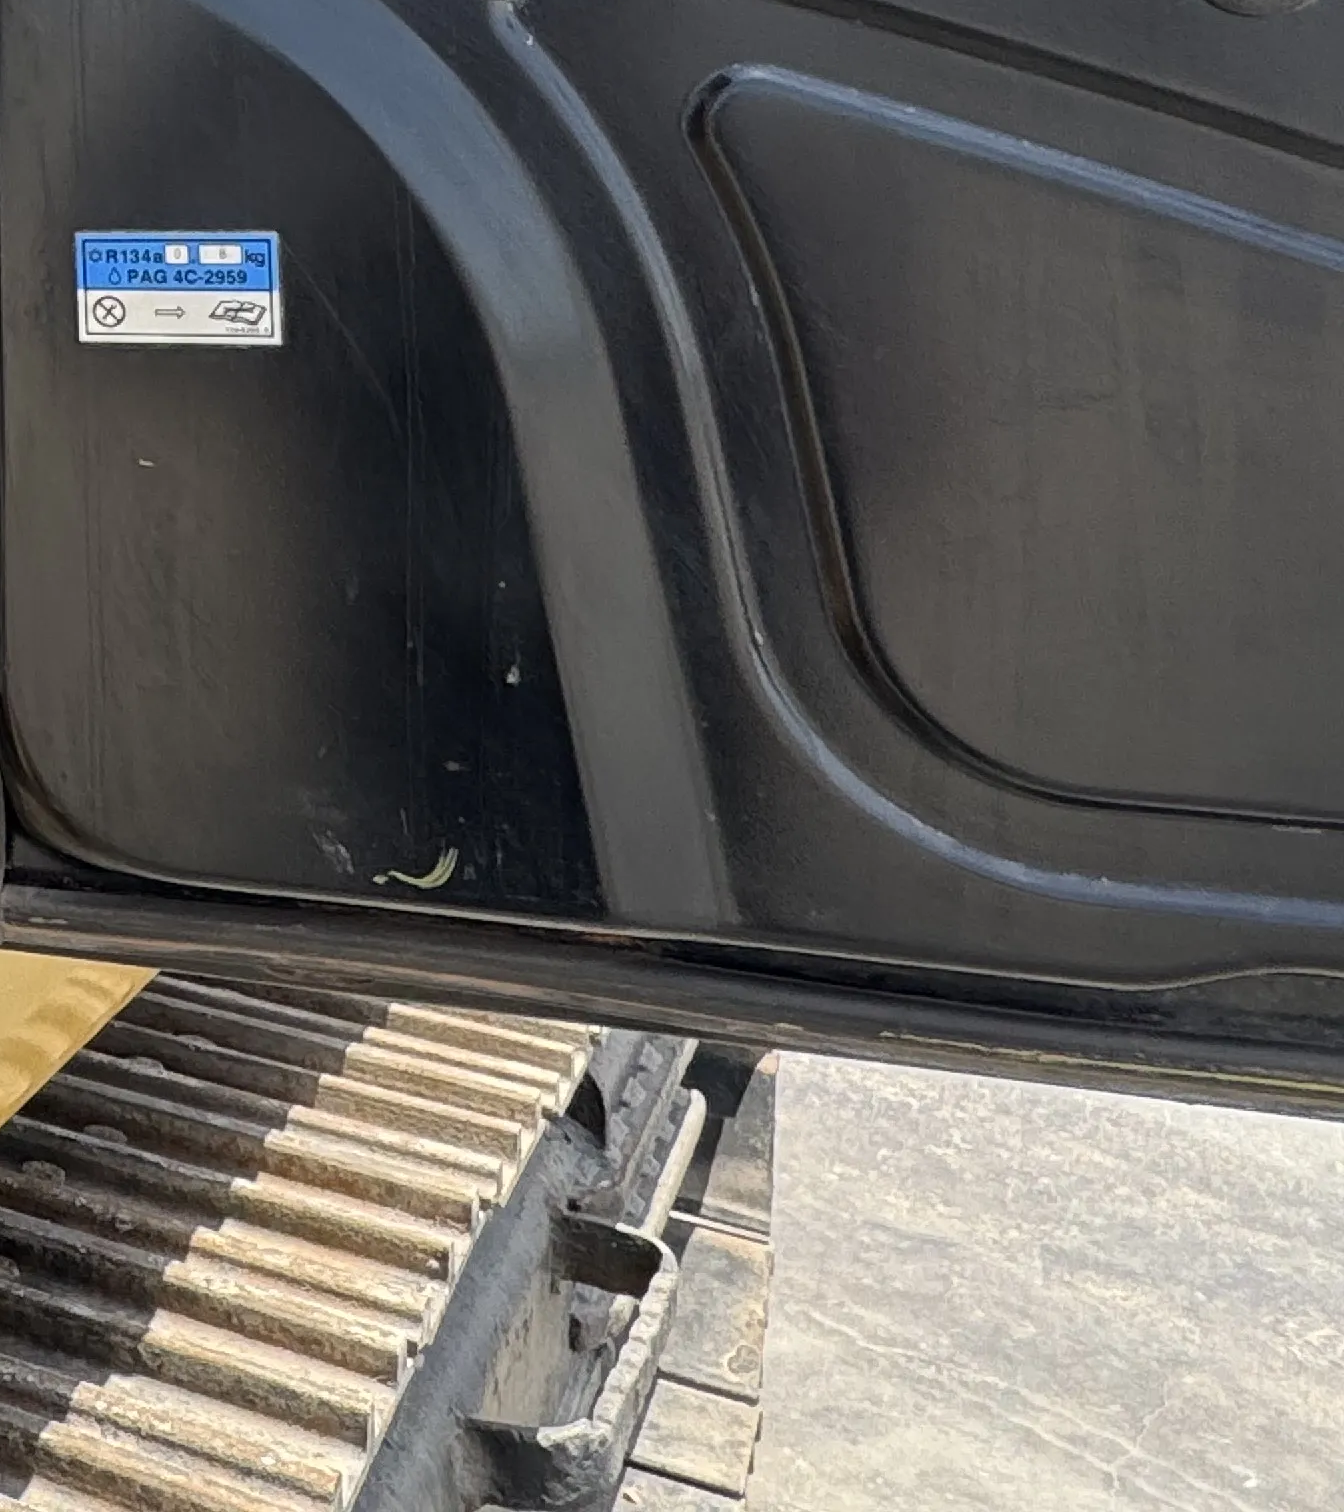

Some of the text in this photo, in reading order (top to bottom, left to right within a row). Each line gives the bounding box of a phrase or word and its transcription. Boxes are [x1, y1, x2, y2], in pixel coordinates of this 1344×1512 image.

[105, 248, 164, 264] R134a
[244, 248, 266, 268] kg
[127, 268, 248, 285] PAG 4C-2959
